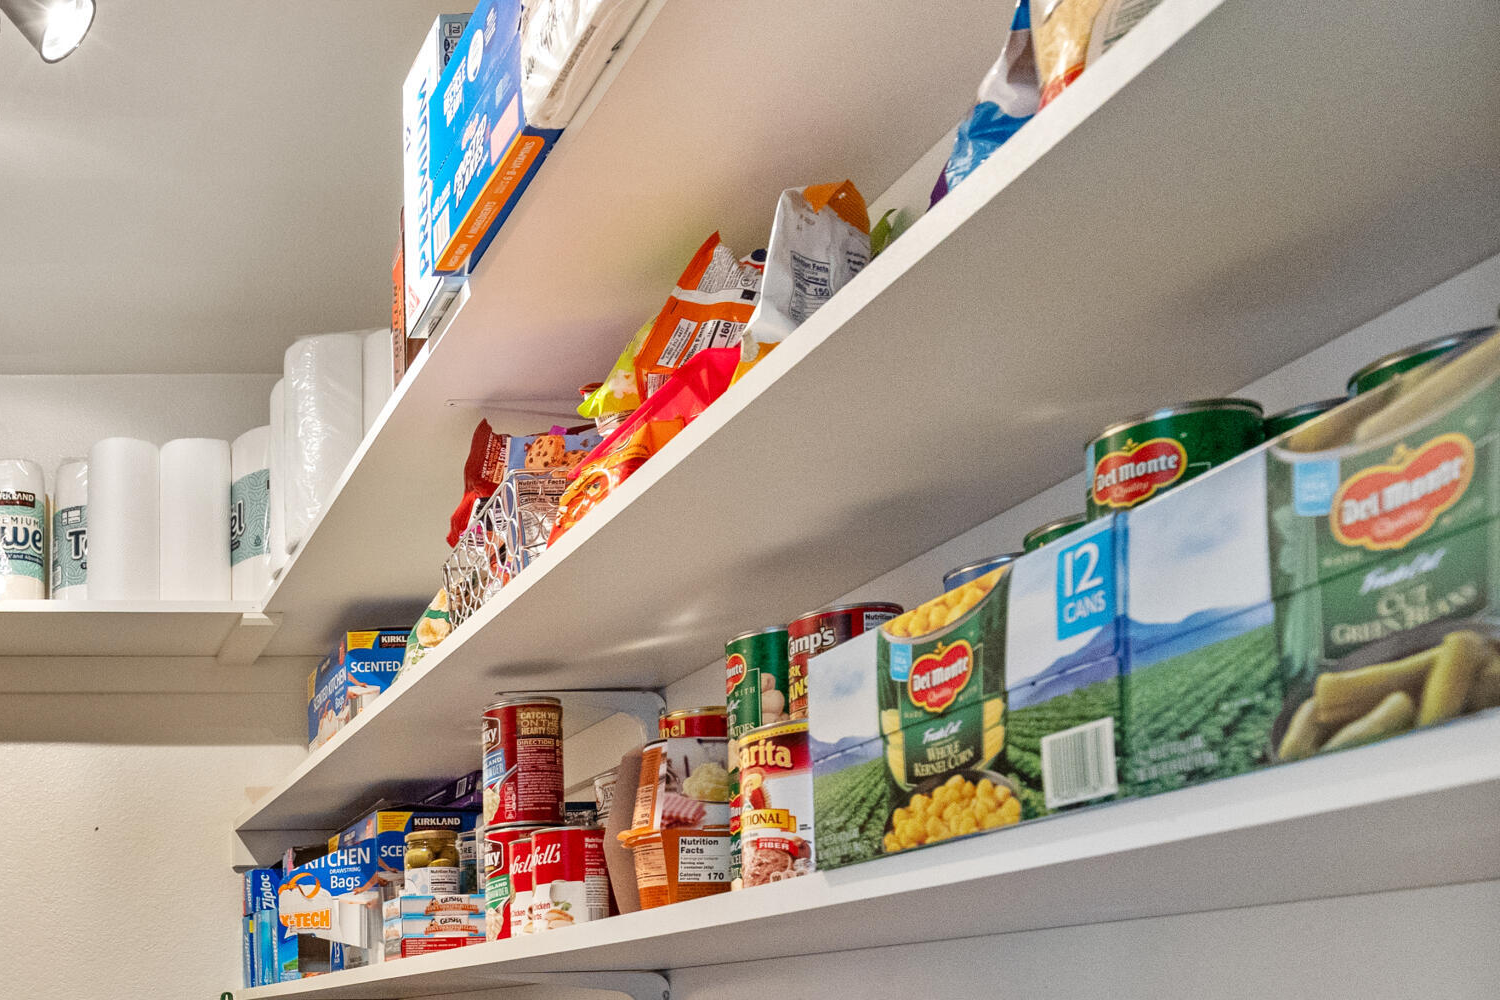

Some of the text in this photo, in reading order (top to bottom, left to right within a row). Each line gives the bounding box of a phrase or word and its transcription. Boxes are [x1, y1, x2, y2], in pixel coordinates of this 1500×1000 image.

[719, 322, 732, 338] 160
[1119, 454, 1178, 482] Monte
[1064, 542, 1104, 597] 12
[1063, 590, 1106, 624] CANS
[350, 661, 401, 673] SCENTED
[913, 656, 969, 692] Del Monte
[520, 711, 544, 719] CATCH
[521, 727, 545, 735] HEARTY
[914, 747, 974, 778] KERNEL CORN
[414, 817, 460, 826] KIRKLAND
[680, 838, 719, 846] Nutrition
[759, 842, 789, 851] FIBER
[680, 846, 704, 854] Facts
[329, 867, 361, 875] DRAWSTRING
[708, 872, 724, 880] 170
[330, 876, 360, 891] Bags
[262, 873, 274, 910] Ziploc
[440, 917, 462, 925] GEISHA
